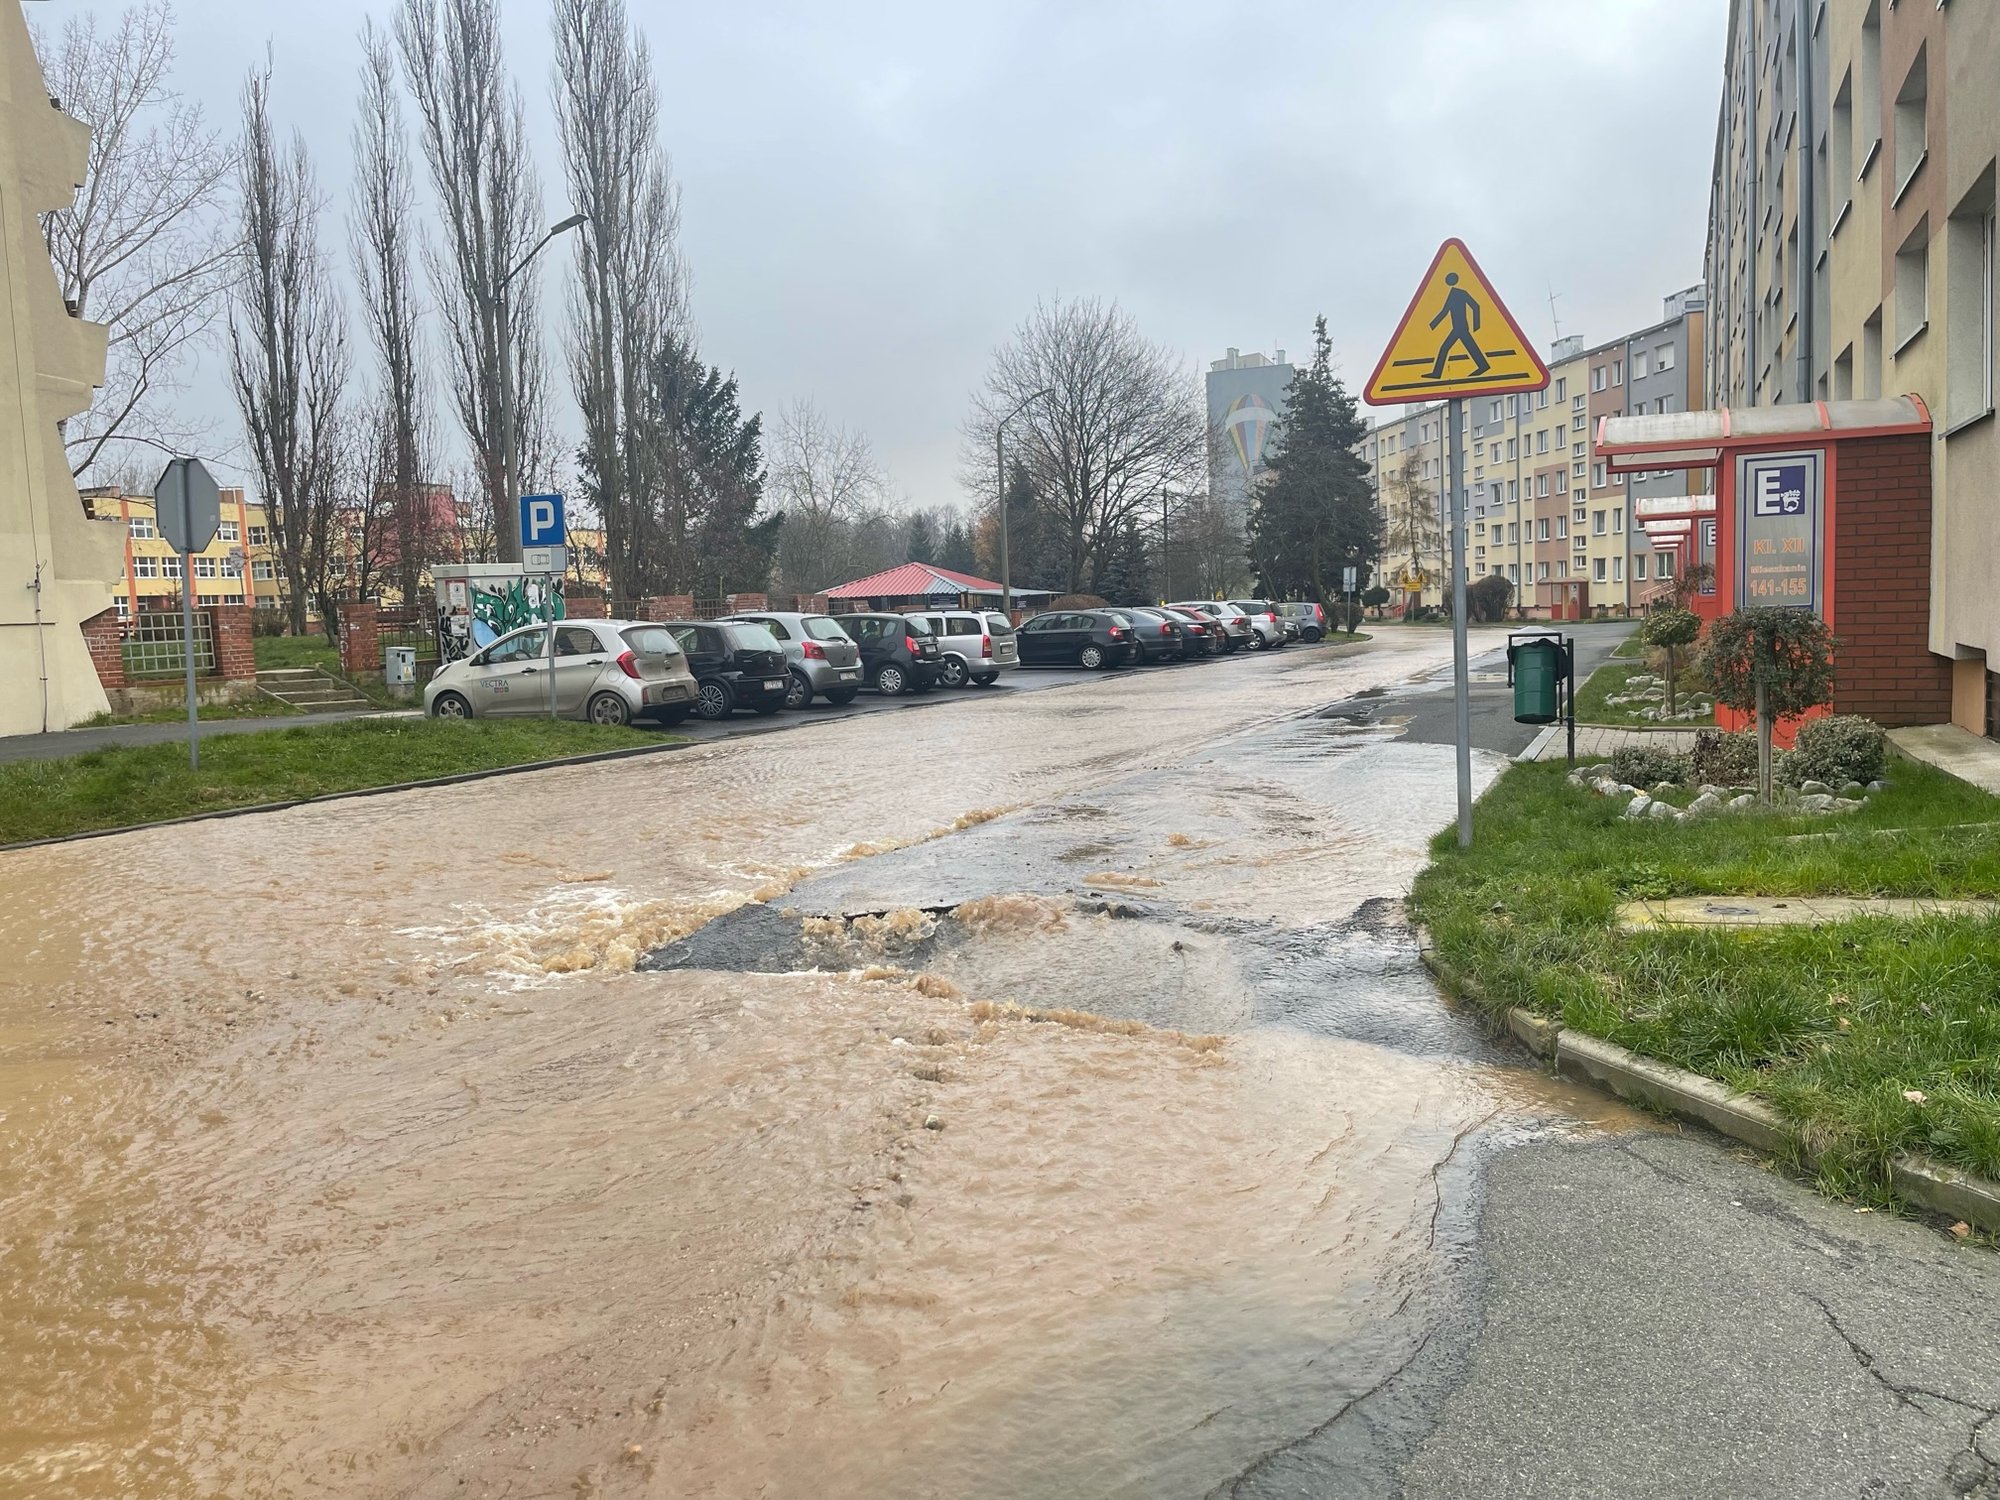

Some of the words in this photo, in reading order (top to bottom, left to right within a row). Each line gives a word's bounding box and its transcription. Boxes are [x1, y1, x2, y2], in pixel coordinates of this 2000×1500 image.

[529, 500, 555, 541] P
[1750, 578, 1808, 597] 141-155
[479, 679, 509, 688] VECTRA
